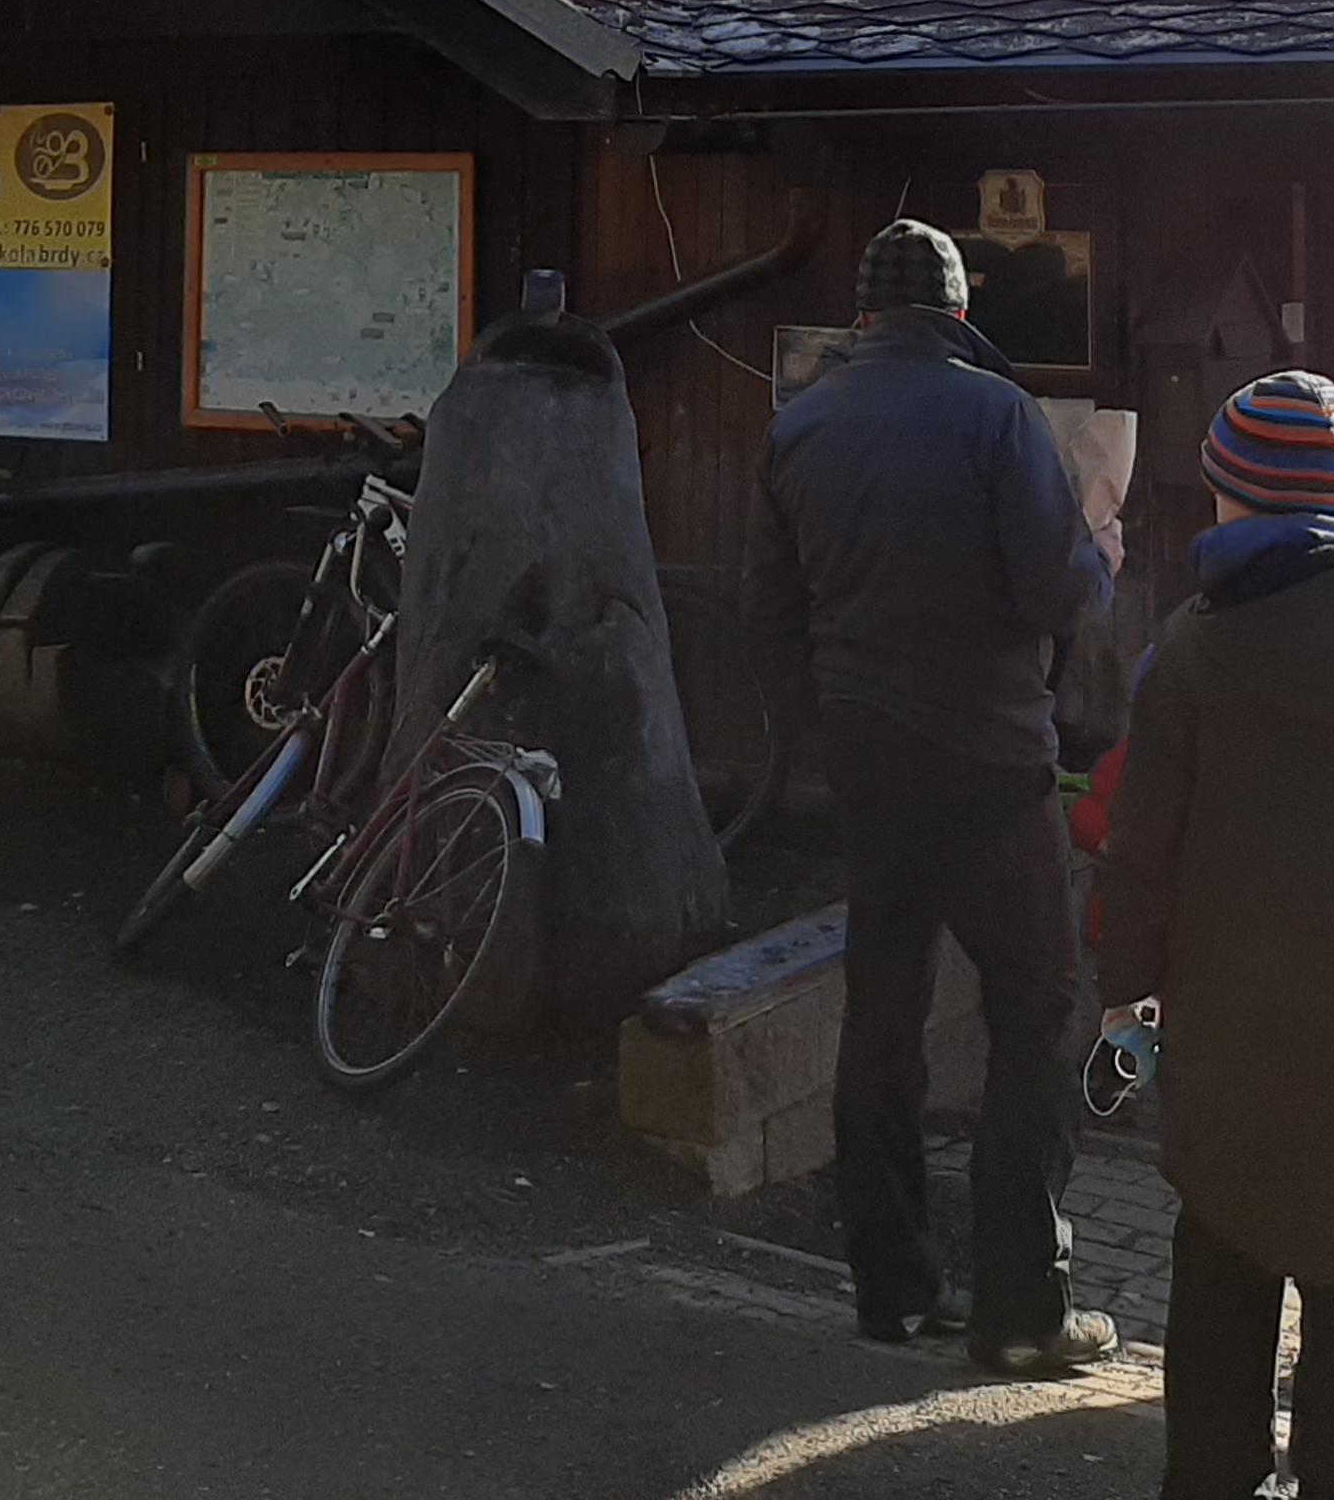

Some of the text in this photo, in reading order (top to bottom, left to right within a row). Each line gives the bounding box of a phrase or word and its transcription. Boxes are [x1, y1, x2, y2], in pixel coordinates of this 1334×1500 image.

[14, 220, 39, 236] 776
[45, 221, 72, 237] 570
[77, 221, 105, 237] 079
